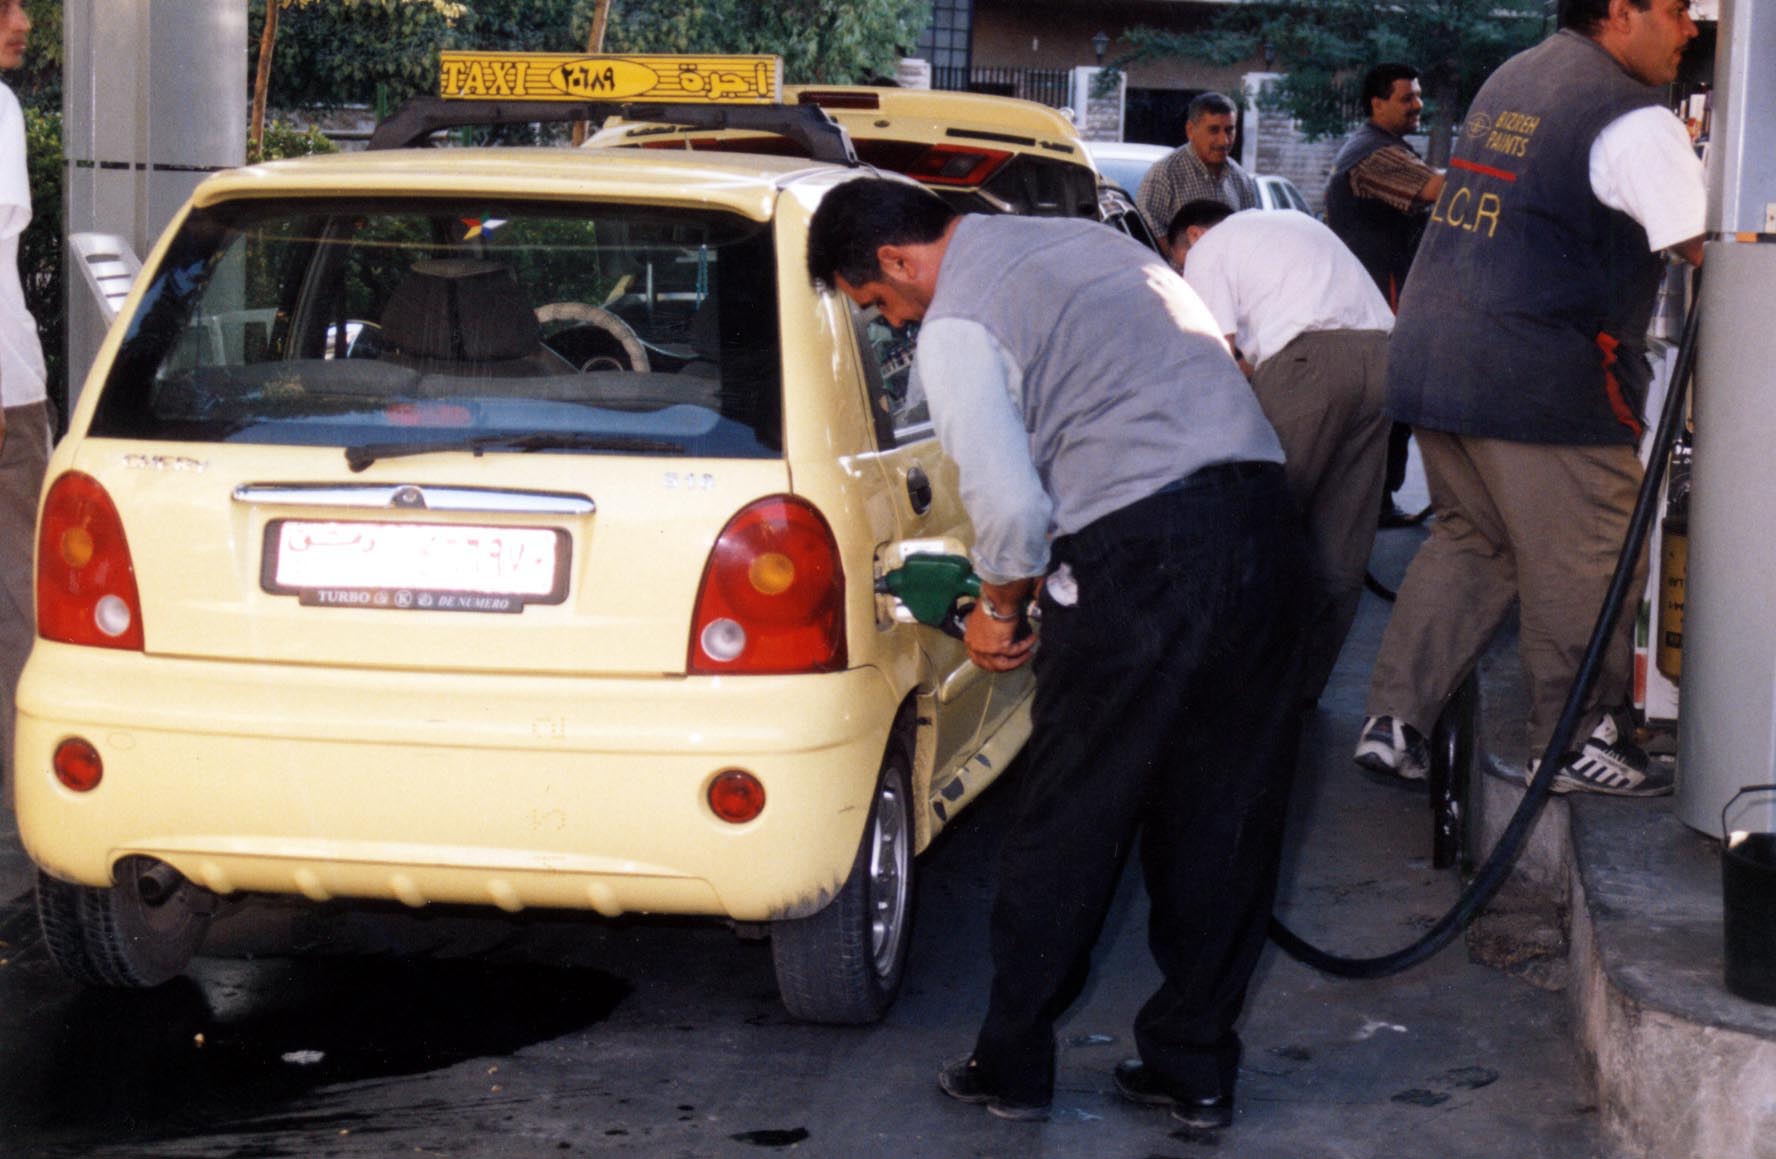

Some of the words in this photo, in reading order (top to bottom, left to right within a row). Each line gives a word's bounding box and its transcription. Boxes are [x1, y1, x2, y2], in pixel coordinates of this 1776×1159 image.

[442, 60, 530, 96] TAXI
[1485, 131, 1530, 158] PAINTS
[318, 590, 371, 603] TURBO
[438, 595, 456, 607] DE
